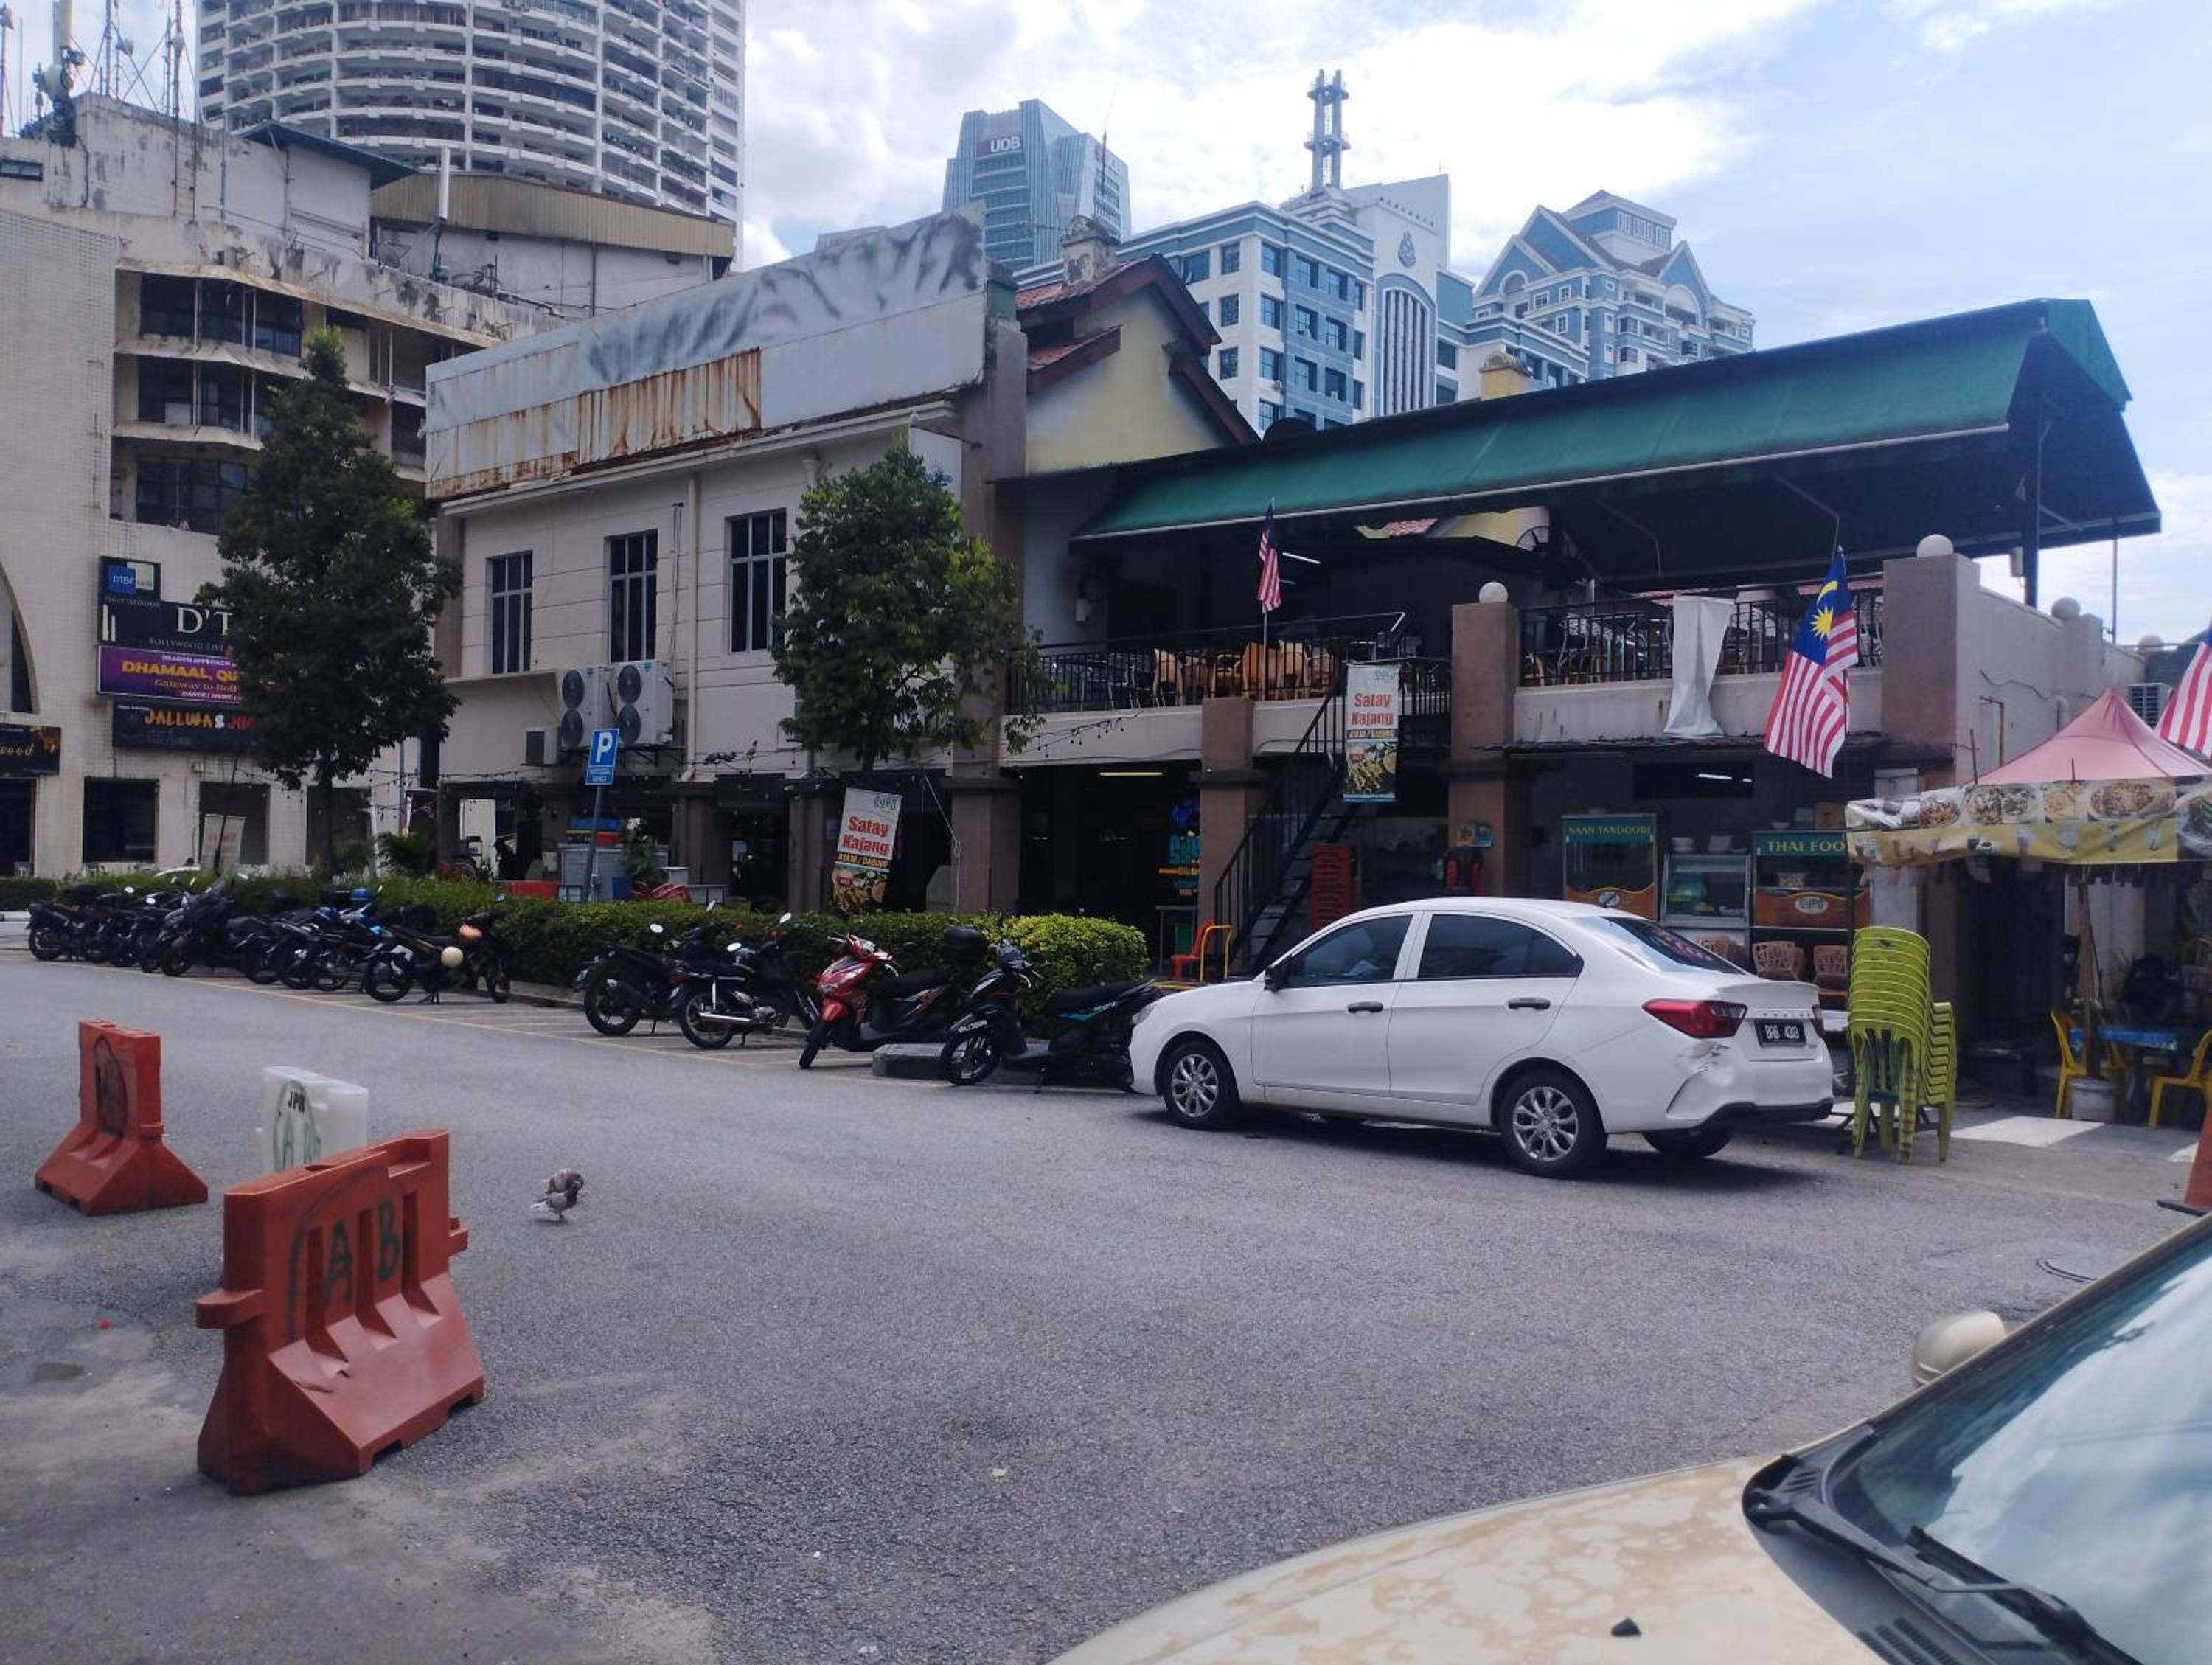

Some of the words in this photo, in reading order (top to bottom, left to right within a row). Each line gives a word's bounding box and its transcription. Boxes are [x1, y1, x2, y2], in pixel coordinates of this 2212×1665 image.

[990, 136, 1021, 153] UOB
[1354, 693, 1391, 709] Satay
[1352, 712, 1394, 726] Kajang
[595, 731, 613, 763] P
[848, 816, 888, 838] Satay
[843, 834, 891, 856] Kajang
[1768, 839, 1805, 852] THAI
[1809, 839, 1847, 852] FOO
